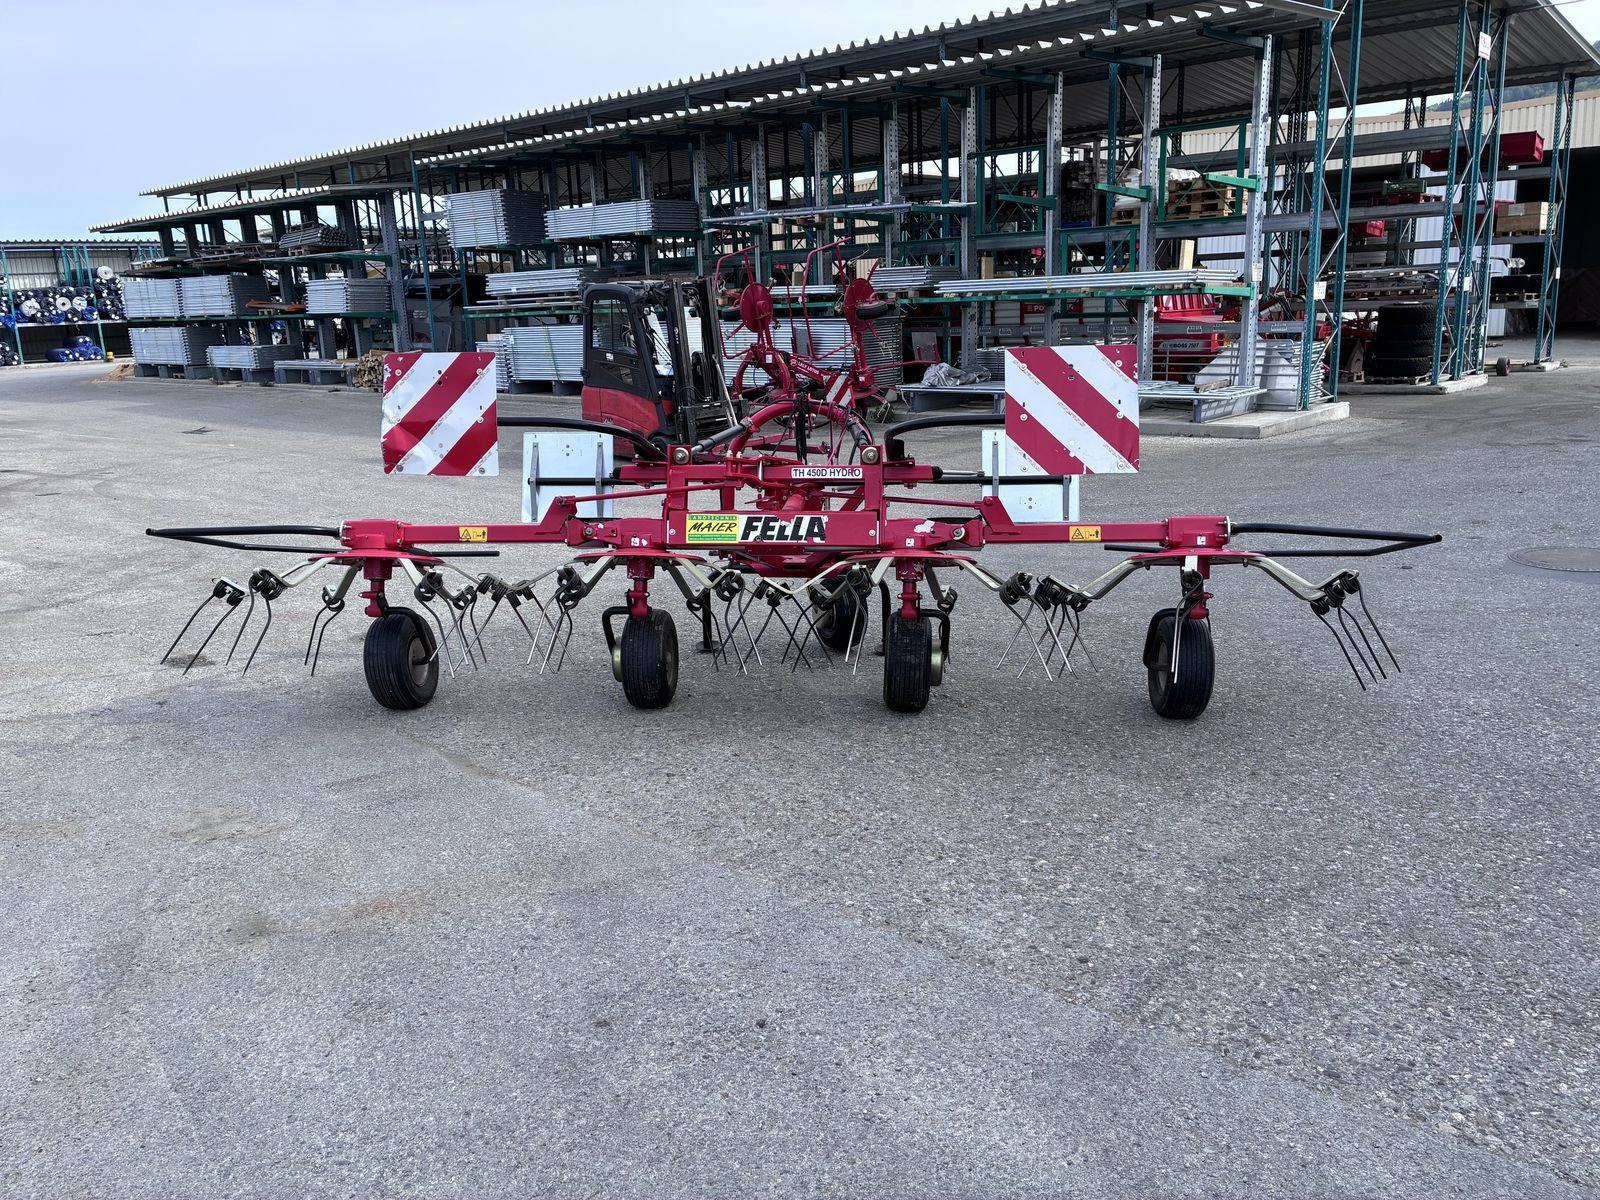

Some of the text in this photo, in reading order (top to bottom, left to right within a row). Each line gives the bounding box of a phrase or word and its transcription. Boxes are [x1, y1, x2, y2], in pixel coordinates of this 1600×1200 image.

[793, 469, 860, 477] TH 450D HYDRO
[688, 522, 737, 532] MAIER
[740, 516, 826, 540] FELLA
